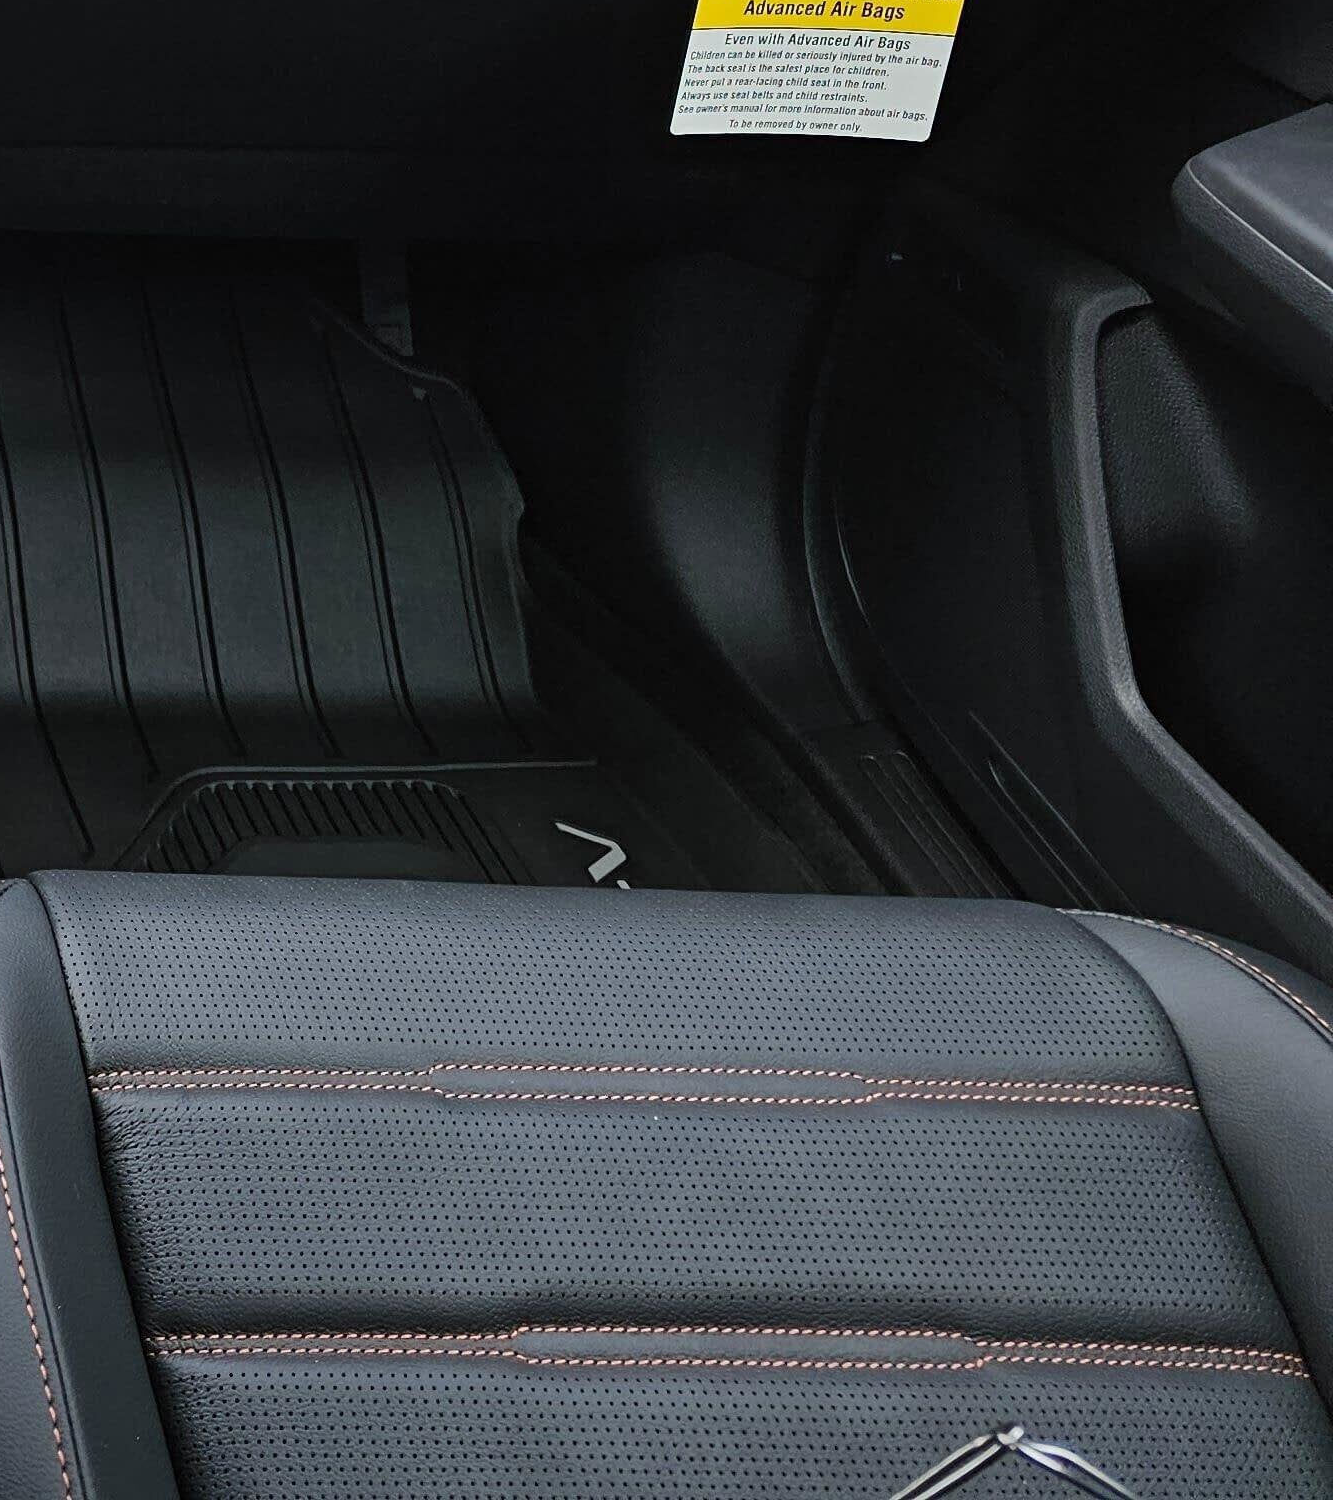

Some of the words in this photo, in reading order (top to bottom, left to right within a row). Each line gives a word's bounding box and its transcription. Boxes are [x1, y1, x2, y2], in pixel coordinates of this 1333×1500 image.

[743, 0, 826, 16] Advanced
[830, 1, 858, 17] Air
[861, 2, 906, 23] Bags
[724, 33, 755, 46] Even
[758, 33, 785, 46] with
[787, 33, 850, 47] Advanced
[853, 35, 874, 48] Air
[877, 36, 912, 52] Bags
[690, 51, 726, 61] Children
[745, 50, 756, 59] be
[757, 49, 783, 59] killed
[784, 52, 794, 60] or
[795, 51, 838, 62] seriously
[839, 51, 873, 63] injured
[875, 53, 886, 65] by
[888, 54, 904, 64] the
[905, 55, 919, 66] air
[921, 56, 942, 69] bag.
[687, 64, 703, 74] The
[704, 64, 726, 73] back
[726, 63, 747, 73] seat
[747, 62, 757, 73] is
[758, 63, 773, 73] the
[774, 63, 803, 73] safest
[803, 64, 830, 75] place
[832, 64, 845, 75] for
[847, 65, 890, 77] children.
[684, 78, 709, 87] Never
[710, 77, 725, 88] put
[734, 77, 784, 88] rear-facing
[785, 77, 809, 87] child
[810, 78, 831, 88] seat
[832, 78, 842, 88] in
[844, 79, 860, 89] the
[861, 80, 887, 91] front.
[680, 91, 711, 102] Always
[713, 92, 729, 100] use
[730, 90, 750, 100] seat
[752, 90, 774, 100] belts
[775, 91, 794, 100] and
[795, 91, 819, 101] child
[820, 92, 868, 103] restraints.
[678, 104, 694, 115] See
[695, 103, 729, 114] owner's
[729, 103, 764, 113] manual
[764, 103, 778, 113] for
[778, 104, 802, 114] more
[804, 104, 857, 116] information
[858, 107, 885, 118] about
[886, 108, 901, 119] air
[901, 109, 929, 122] bags.
[728, 119, 739, 129] To
[740, 119, 753, 129] be
[754, 119, 795, 130] removed
[795, 119, 807, 131] by
[809, 121, 838, 131] owner
[840, 121, 863, 134] only.
